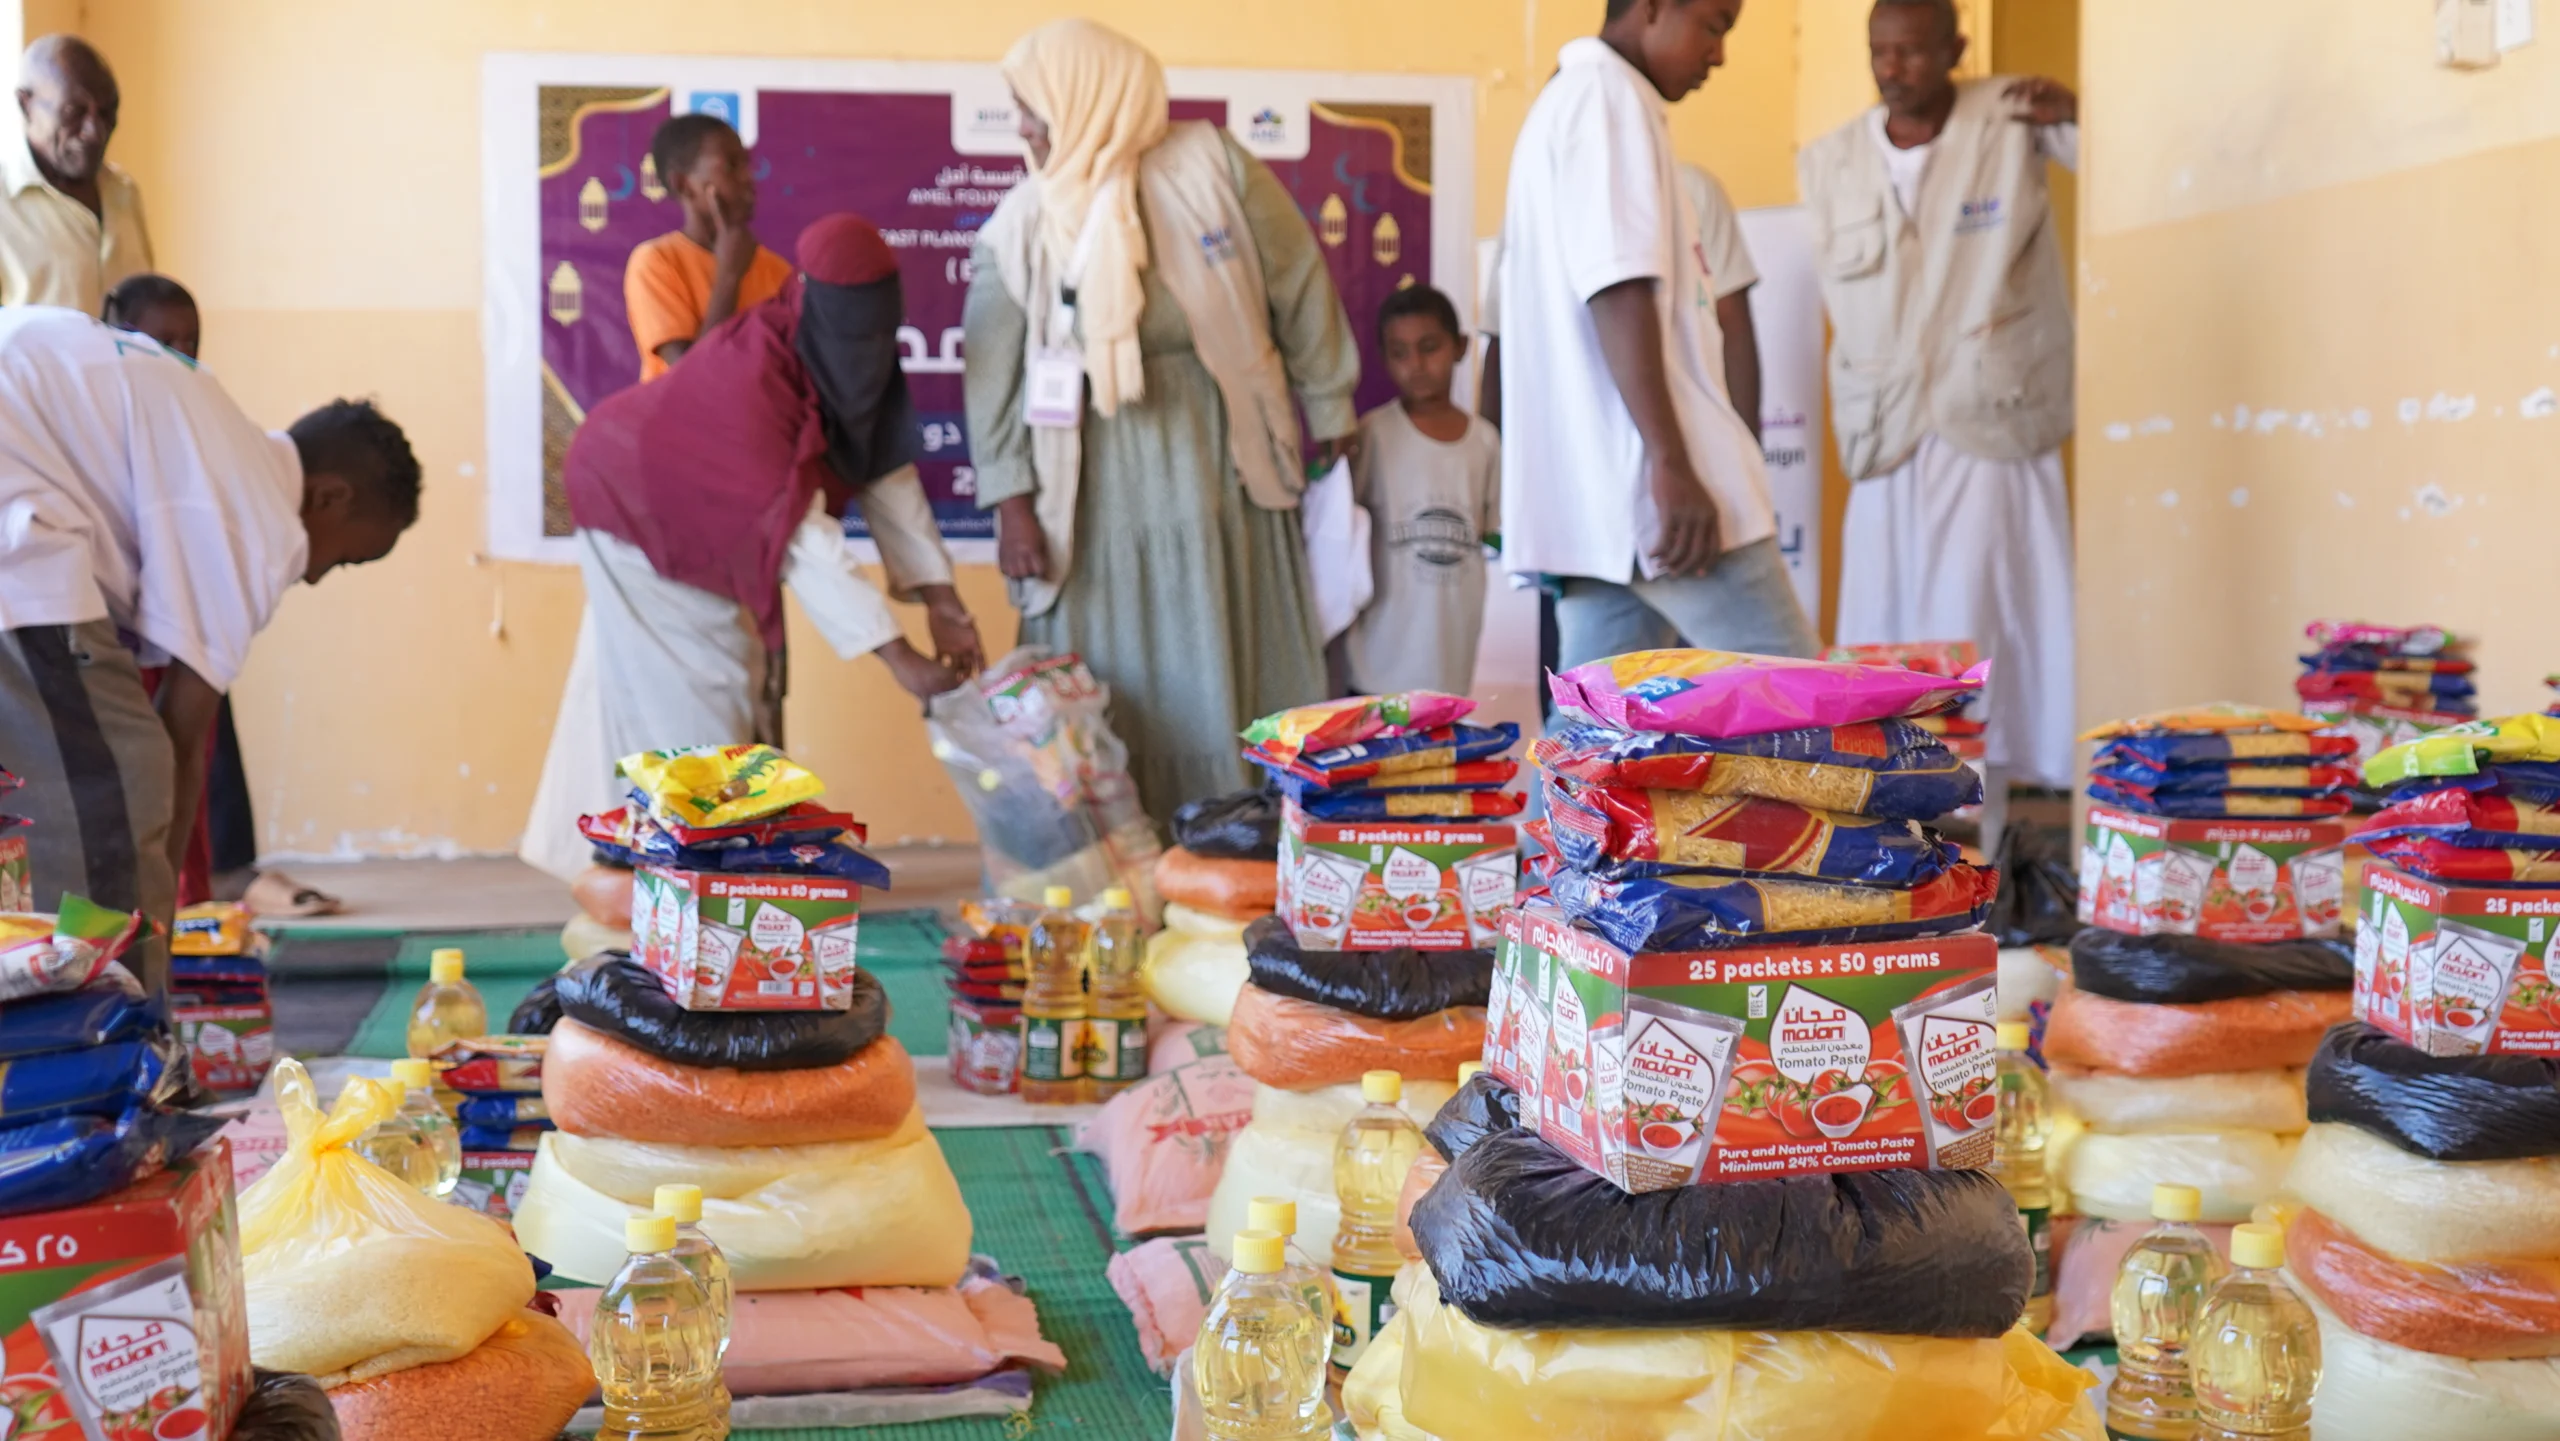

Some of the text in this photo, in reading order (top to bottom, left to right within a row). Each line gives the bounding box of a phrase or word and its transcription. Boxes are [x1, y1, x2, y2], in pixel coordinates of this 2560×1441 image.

[907, 187, 952, 206] AMEL
[1358, 830, 1411, 845] packets
[1443, 832, 1485, 846] grams
[728, 882, 779, 897] packets
[809, 887, 848, 900] grams
[2485, 898, 2560, 916] 25 packe
[1689, 952, 1941, 984] 25 packets x 50 grams
[1783, 1006, 1847, 1025] مجان
[1782, 1023, 1845, 1043] majan
[1925, 1024, 1980, 1053] مجان
[1639, 1040, 1699, 1067] مجان
[1927, 1039, 1981, 1068] majan
[2501, 1040, 2550, 1051] Minimum
[1632, 1056, 1693, 1081] majan
[1777, 1053, 1867, 1069] Tomato Paste
[1931, 1070, 1970, 1091] Tomato
[1622, 1078, 1705, 1108] Tomato Paste
[1719, 1137, 1915, 1160] Pure and Natural Tomato Paste
[1719, 1150, 1912, 1174] Minimum 24% Concentrate
[36, 1234, 79, 1264] ٢٥
[85, 1322, 164, 1360] مجان
[90, 1338, 169, 1379] majan
[100, 1377, 157, 1405] Tomato
